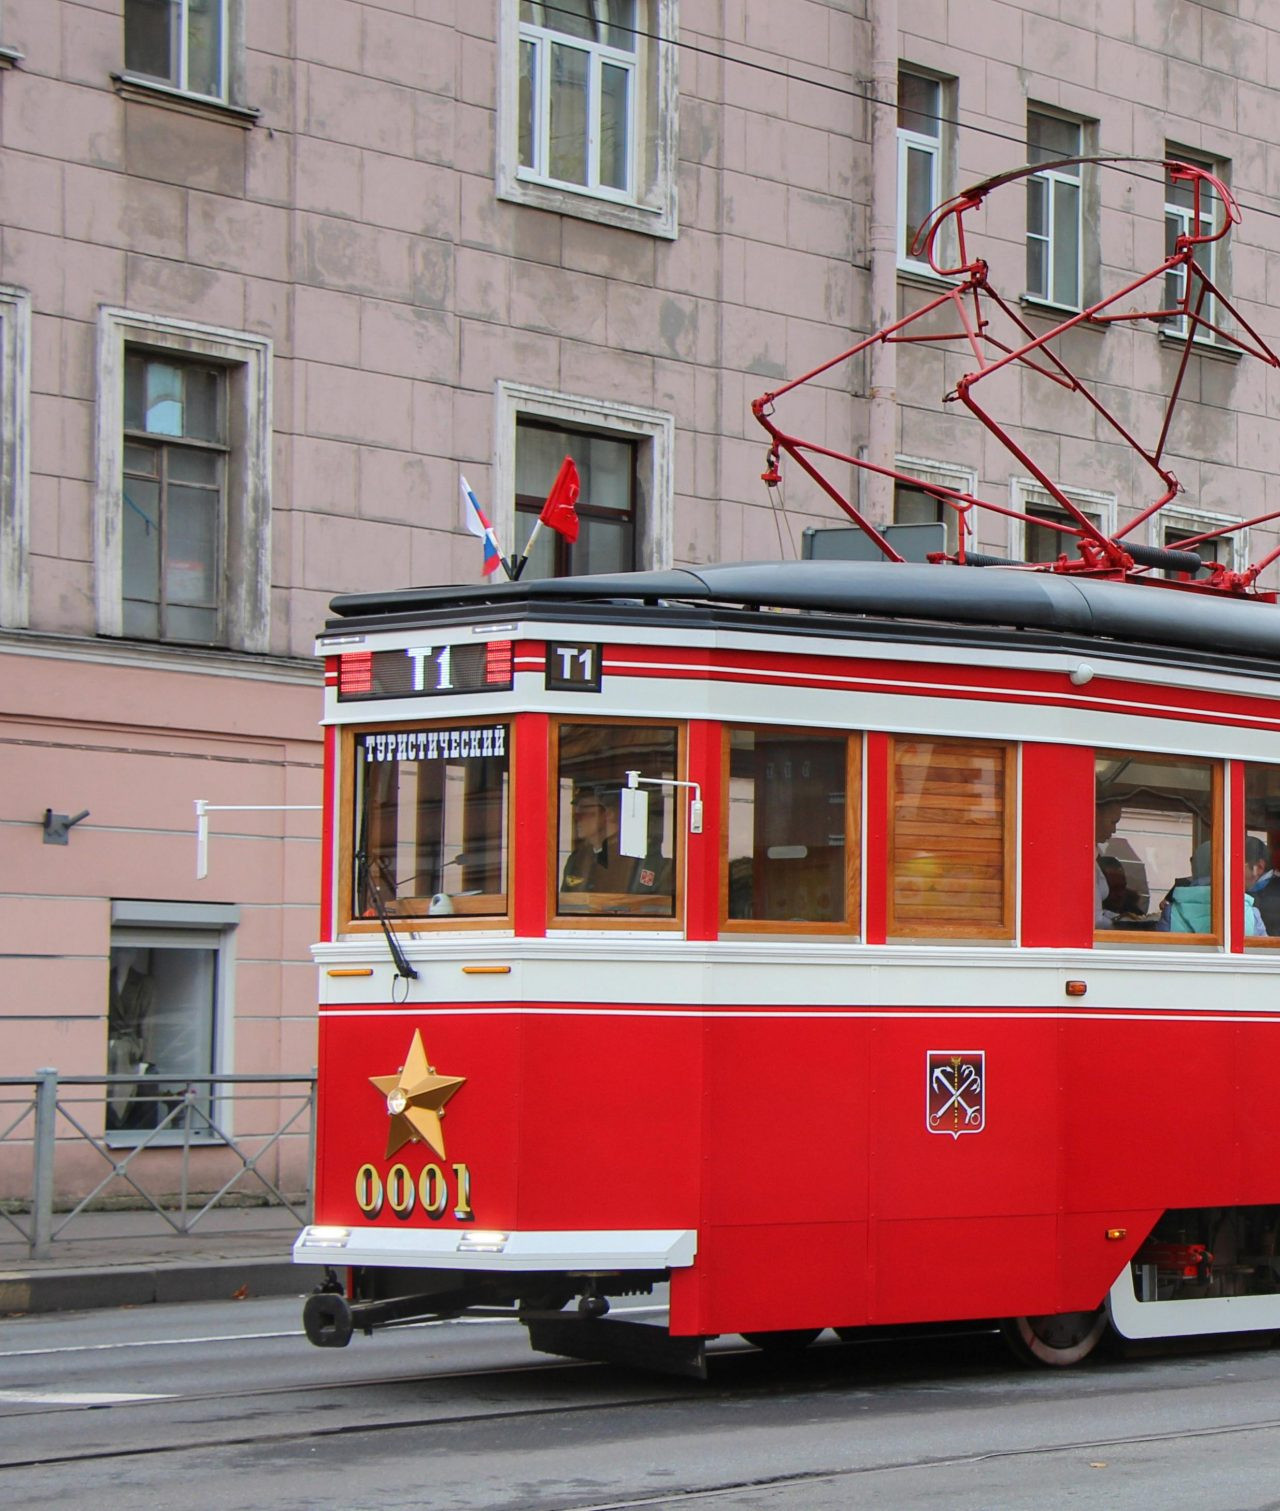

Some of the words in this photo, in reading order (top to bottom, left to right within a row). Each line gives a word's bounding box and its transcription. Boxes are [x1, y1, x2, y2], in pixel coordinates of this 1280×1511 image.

[406, 645, 454, 691] Т1
[556, 647, 593, 681] Т1
[365, 725, 506, 763] ТУРИСТИЧЕСКИЙ
[355, 1163, 474, 1221] 0001
